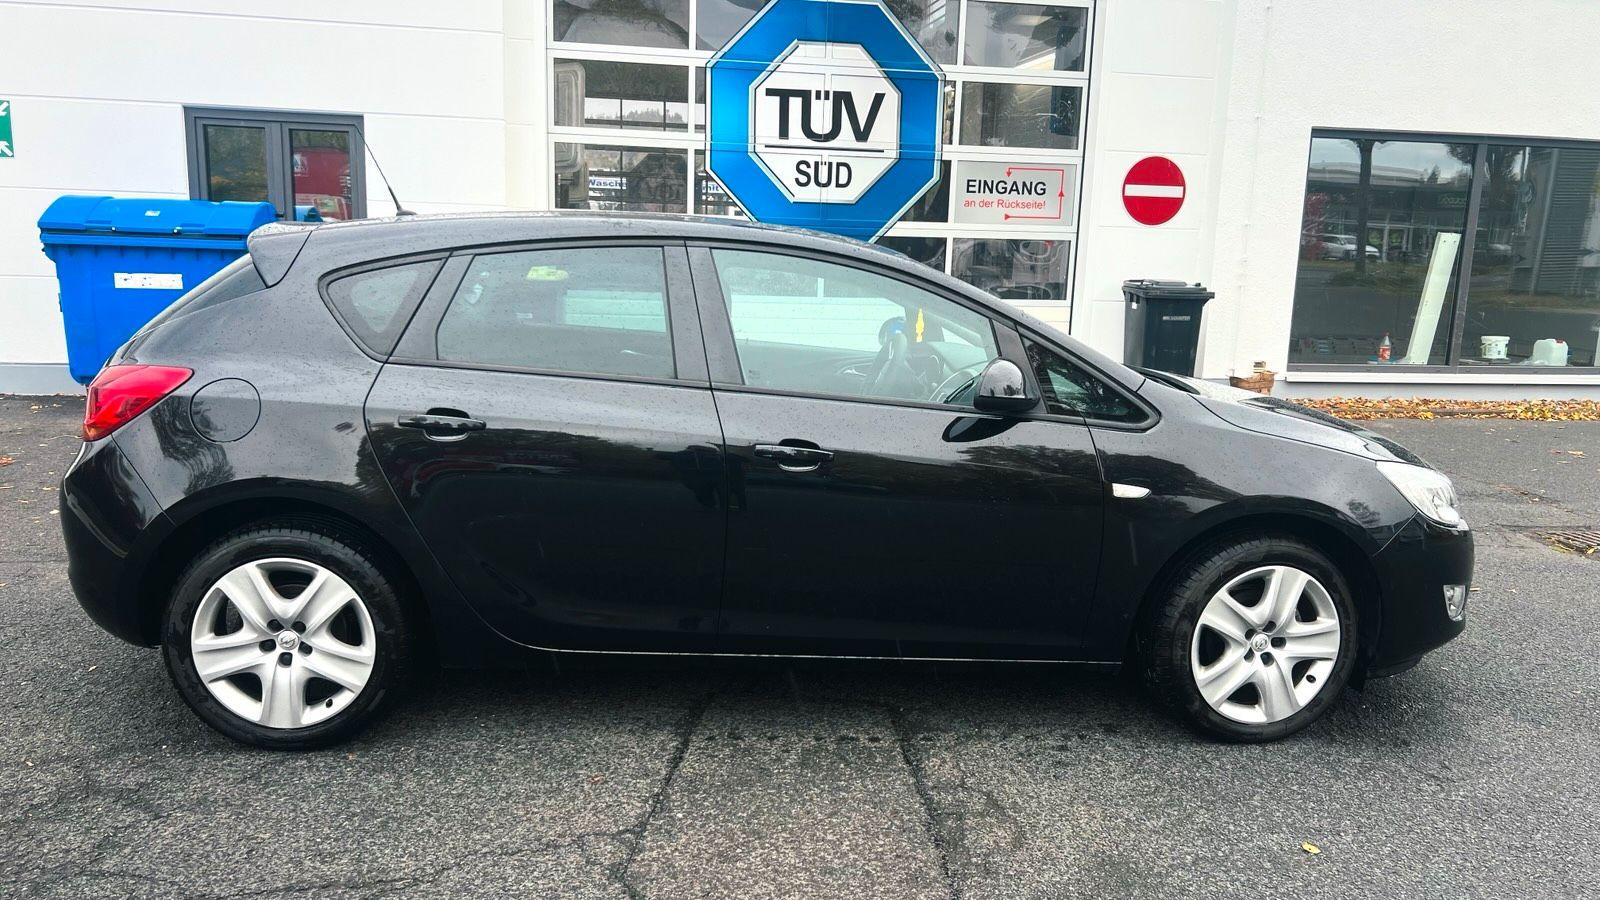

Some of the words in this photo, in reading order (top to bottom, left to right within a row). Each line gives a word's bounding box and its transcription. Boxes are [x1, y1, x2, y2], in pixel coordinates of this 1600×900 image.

[765, 87, 886, 143] TÜV
[794, 160, 853, 188] SÜD
[965, 179, 1047, 196] EINGANG
[963, 199, 976, 208] an
[978, 198, 994, 209] der
[996, 198, 1046, 210] Rückseite!
